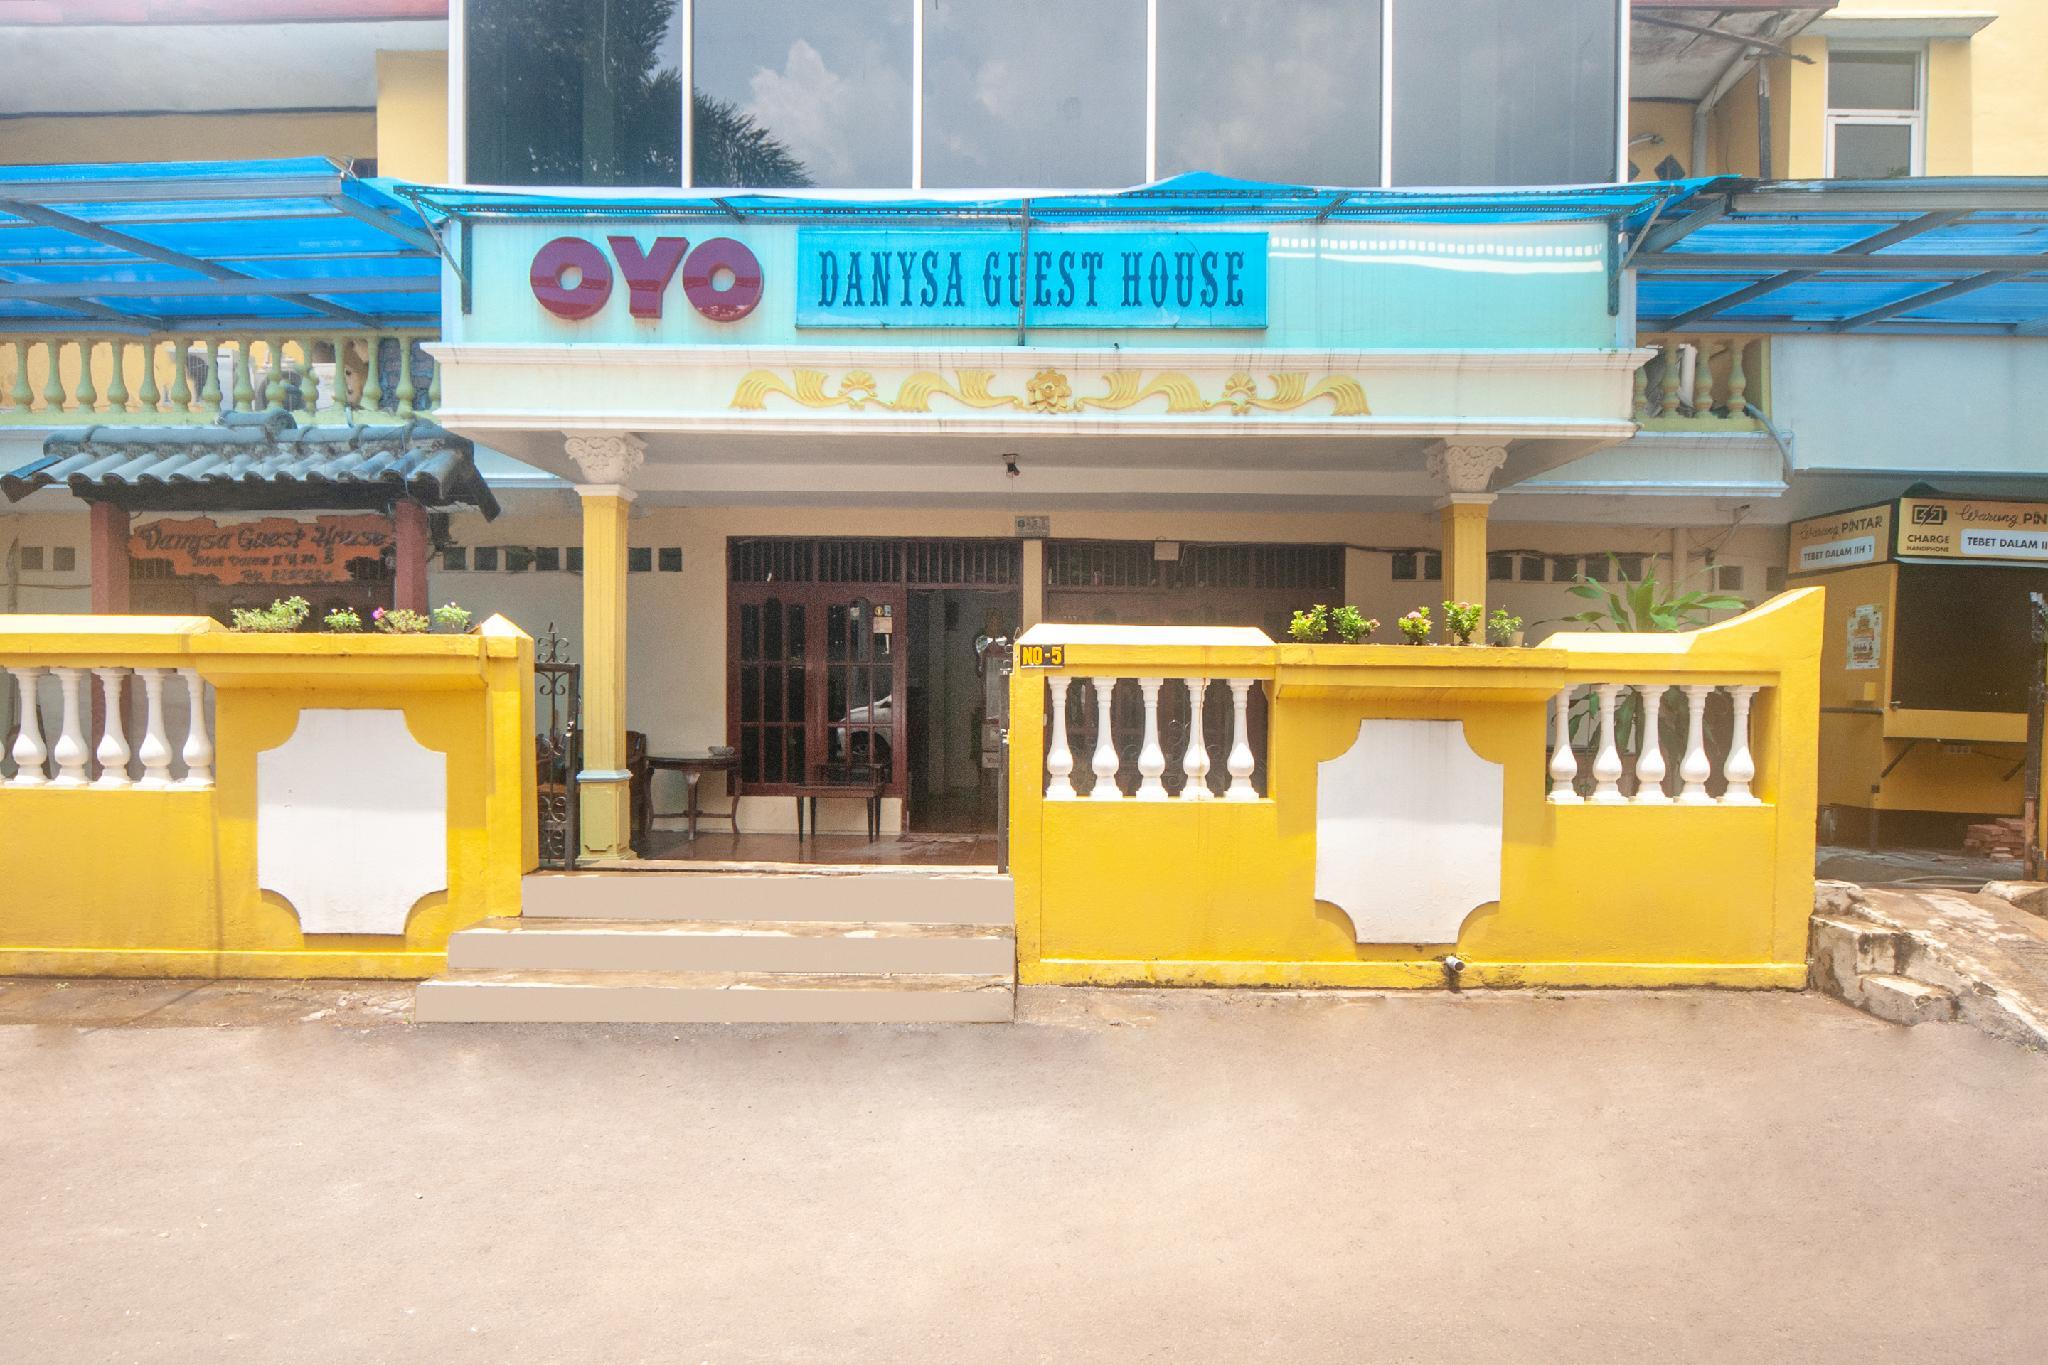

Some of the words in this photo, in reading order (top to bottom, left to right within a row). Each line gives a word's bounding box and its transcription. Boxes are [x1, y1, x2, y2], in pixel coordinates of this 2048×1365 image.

[530, 236, 764, 322] OYO
[818, 251, 965, 307] DANYSA
[983, 251, 1103, 307] GUEST
[1120, 251, 1245, 308] HOUSE
[1841, 515, 1883, 533] PINTAR
[141, 526, 232, 555] Danysa
[237, 526, 306, 550] Guest
[1907, 534, 1950, 544] CHARGE
[1967, 536, 1996, 547] TEBET
[1999, 539, 2038, 549] DALAM
[1804, 551, 1824, 561] TEBET
[1825, 546, 1852, 558] DALAM
